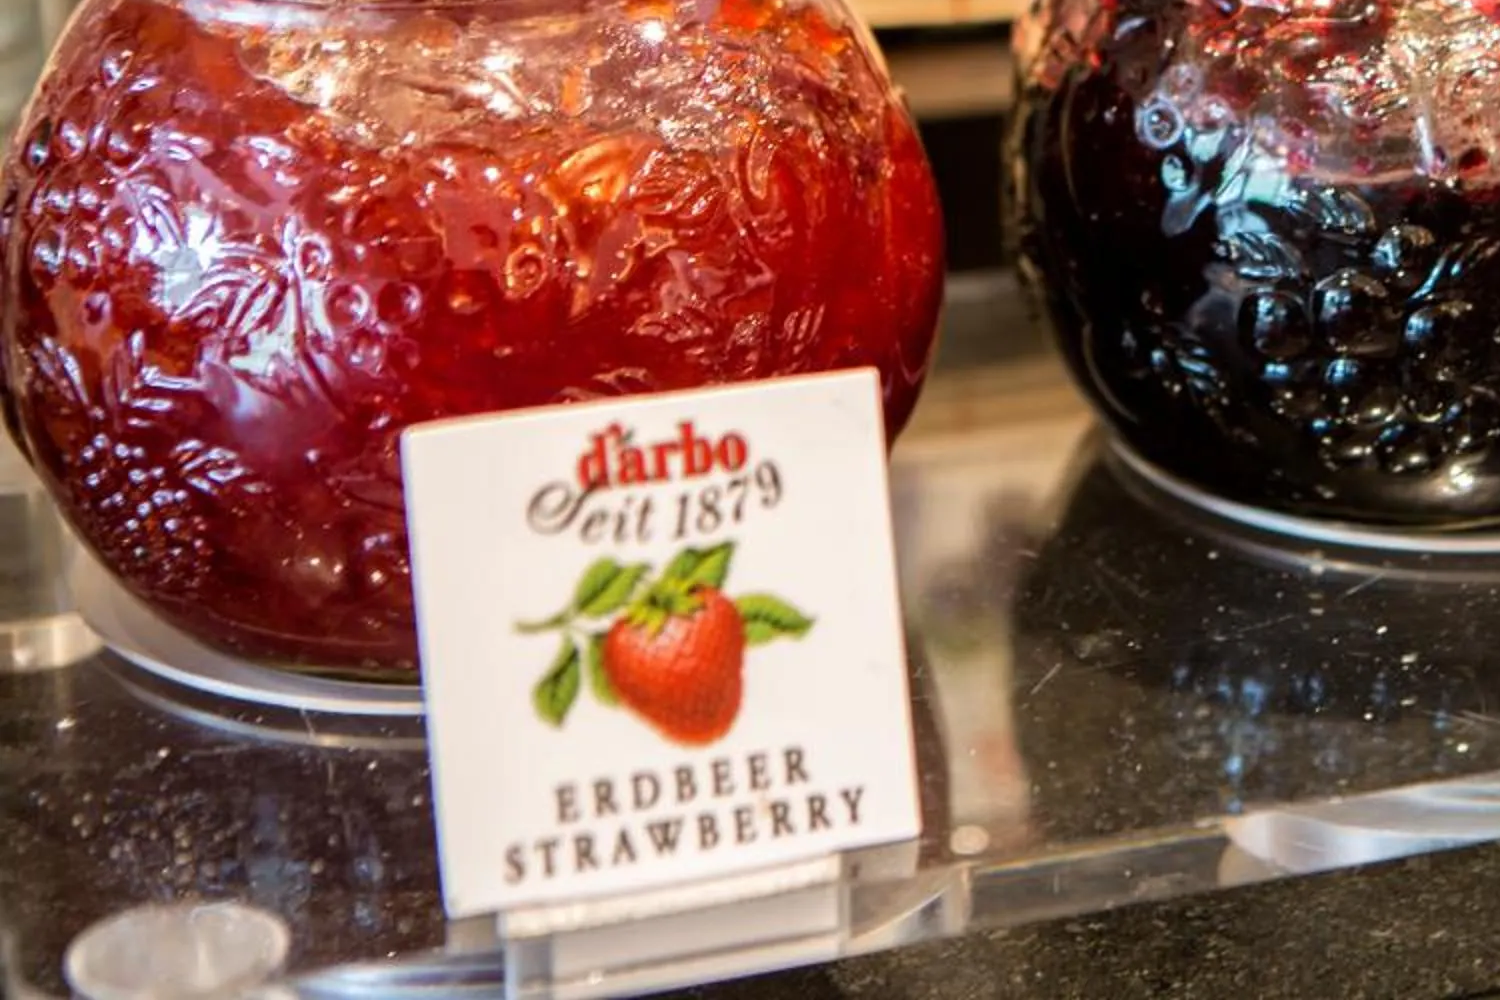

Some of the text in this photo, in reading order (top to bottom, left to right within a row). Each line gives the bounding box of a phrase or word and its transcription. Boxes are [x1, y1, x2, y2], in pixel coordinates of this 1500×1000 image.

[525, 458, 785, 546] Seit 1879
[554, 744, 812, 825] ERDBEER
[503, 786, 866, 887] STRAWBERRY
